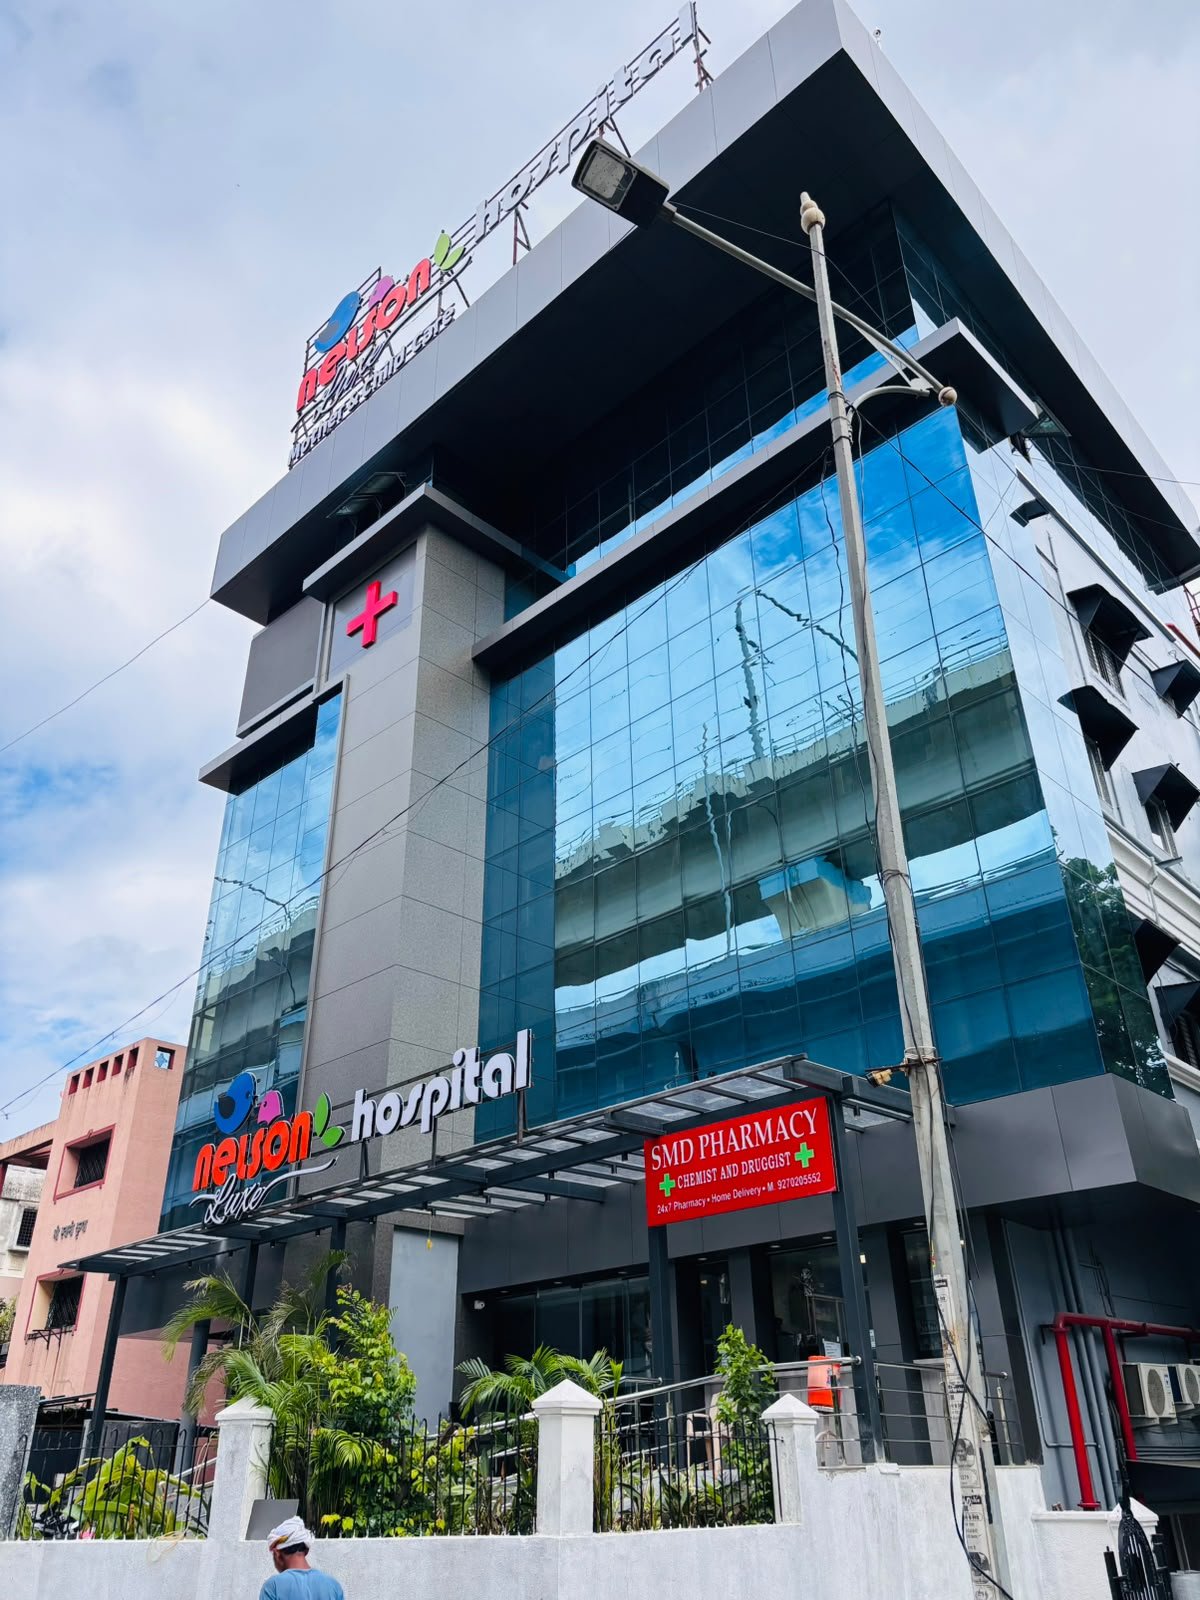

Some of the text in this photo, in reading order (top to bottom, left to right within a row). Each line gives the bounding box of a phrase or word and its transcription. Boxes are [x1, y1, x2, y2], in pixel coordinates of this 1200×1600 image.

[296, 1, 695, 413] nelson hospital
[192, 1028, 533, 1192] nelson hospital
[651, 1107, 818, 1171] SMD PHARMACY
[657, 1203, 672, 1215] 24x7
[673, 1197, 706, 1211] Pharmacy
[711, 1193, 731, 1203] Home
[733, 1187, 762, 1200] Delivery
[777, 1171, 822, 1191] 9270205552
[677, 1151, 792, 1189] CHEMIST AND DRUGGIST
